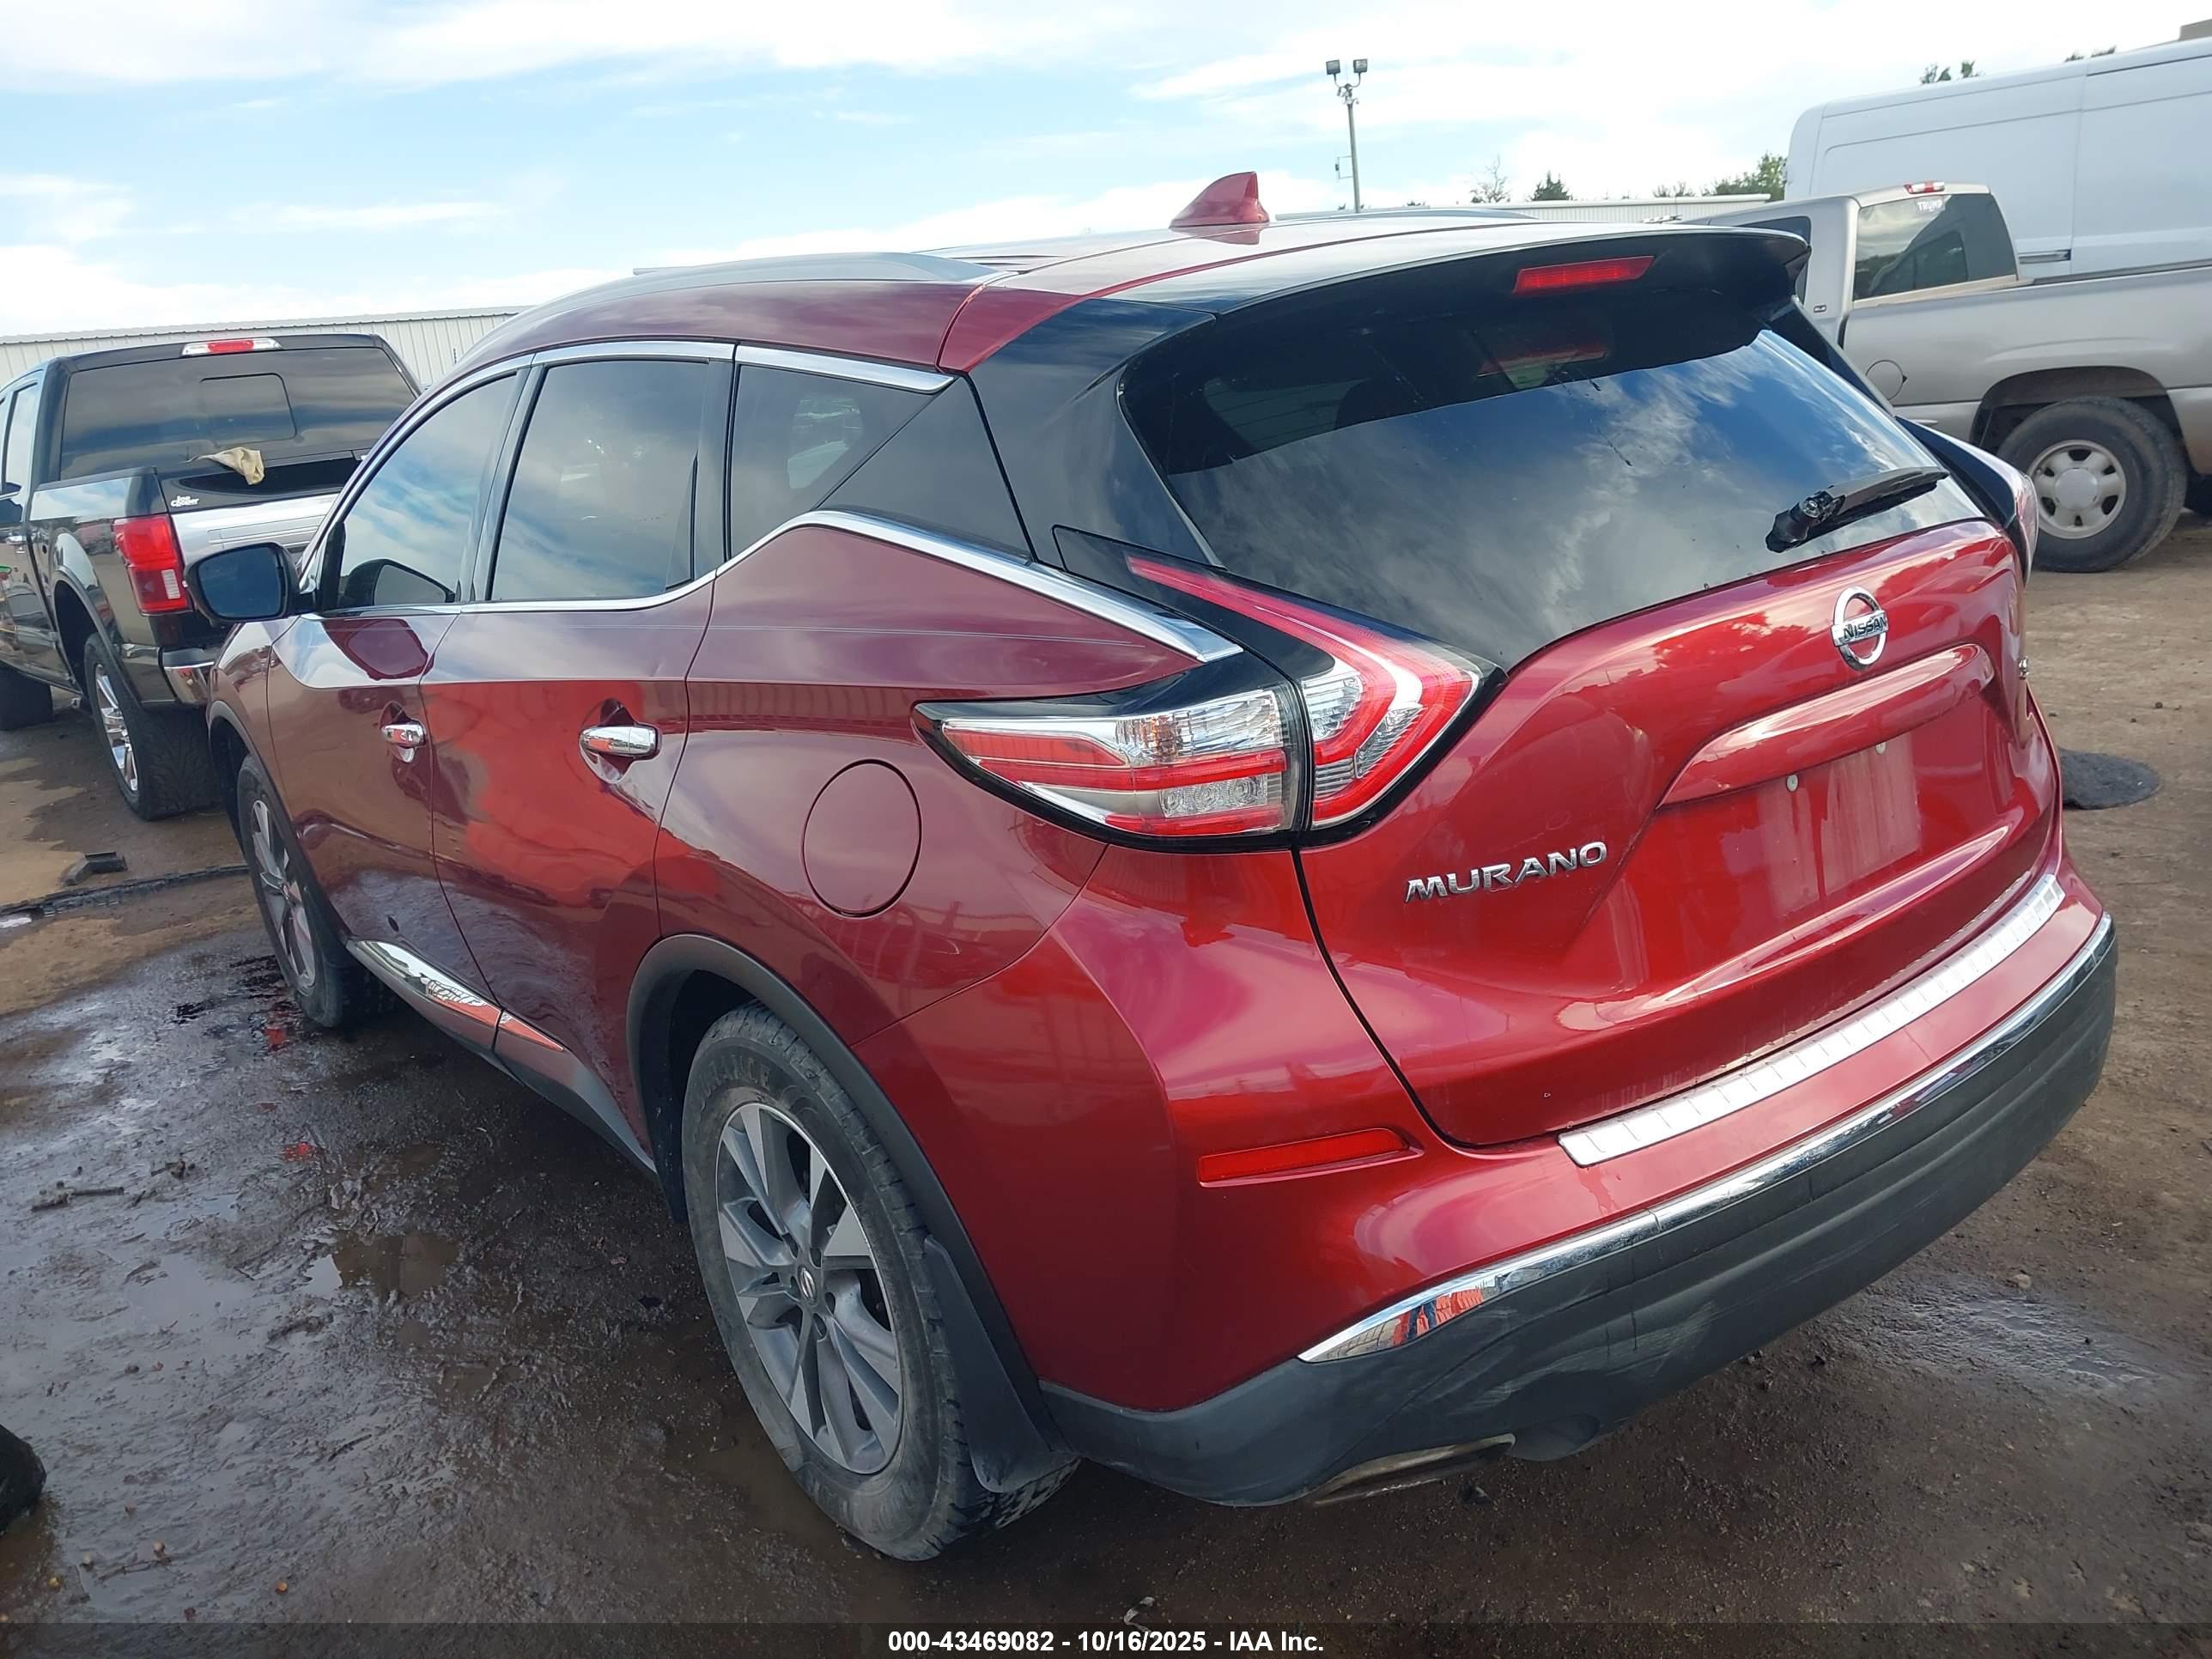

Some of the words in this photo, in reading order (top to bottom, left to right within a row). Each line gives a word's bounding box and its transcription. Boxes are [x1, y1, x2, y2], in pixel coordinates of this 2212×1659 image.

[1917, 199, 1942, 210] TRUMP
[1843, 616, 1887, 640] NISSAN
[1405, 841, 1607, 903] MURANO
